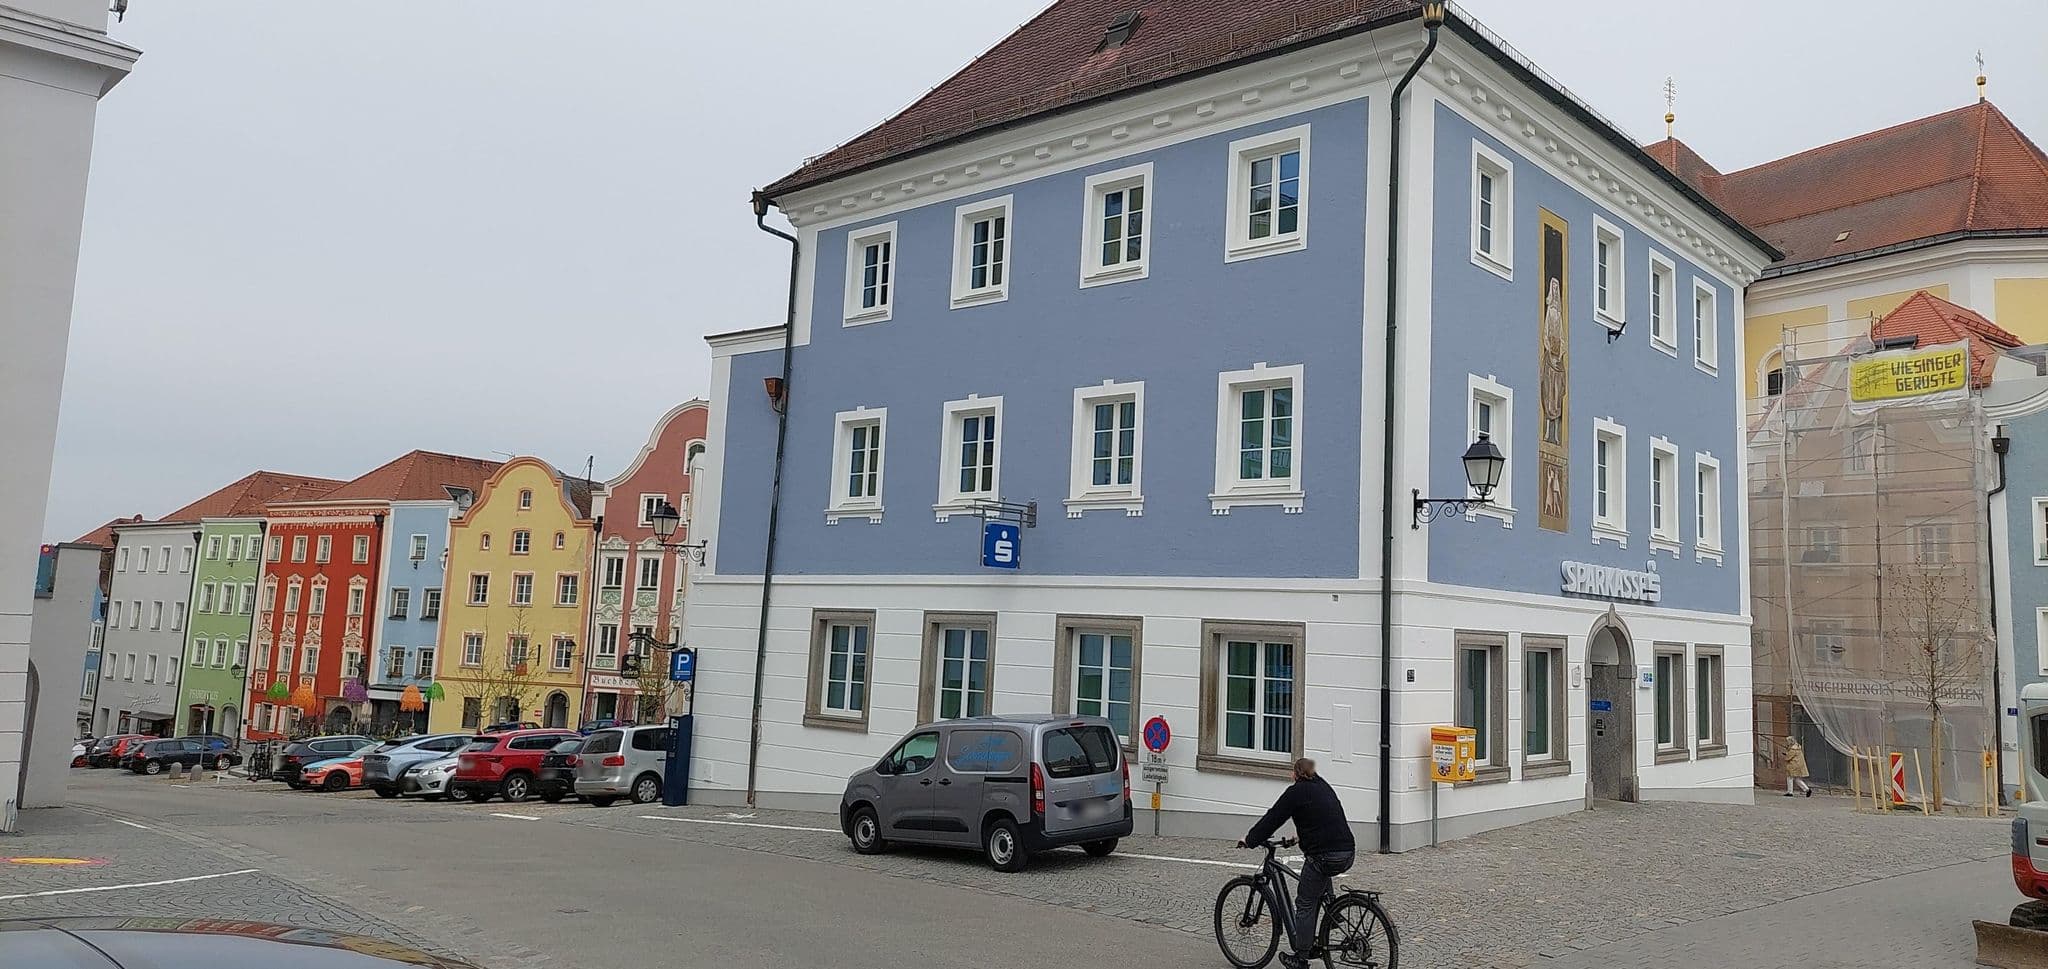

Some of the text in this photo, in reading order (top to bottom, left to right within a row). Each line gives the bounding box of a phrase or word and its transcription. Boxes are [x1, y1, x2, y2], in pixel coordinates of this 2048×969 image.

[1891, 353, 1961, 376] WIESINGER
[1561, 560, 1648, 601] SPARKASSE
[677, 653, 690, 670] P
[1794, 679, 1982, 701] VRSICHERUNGEN IMMBILIEN
